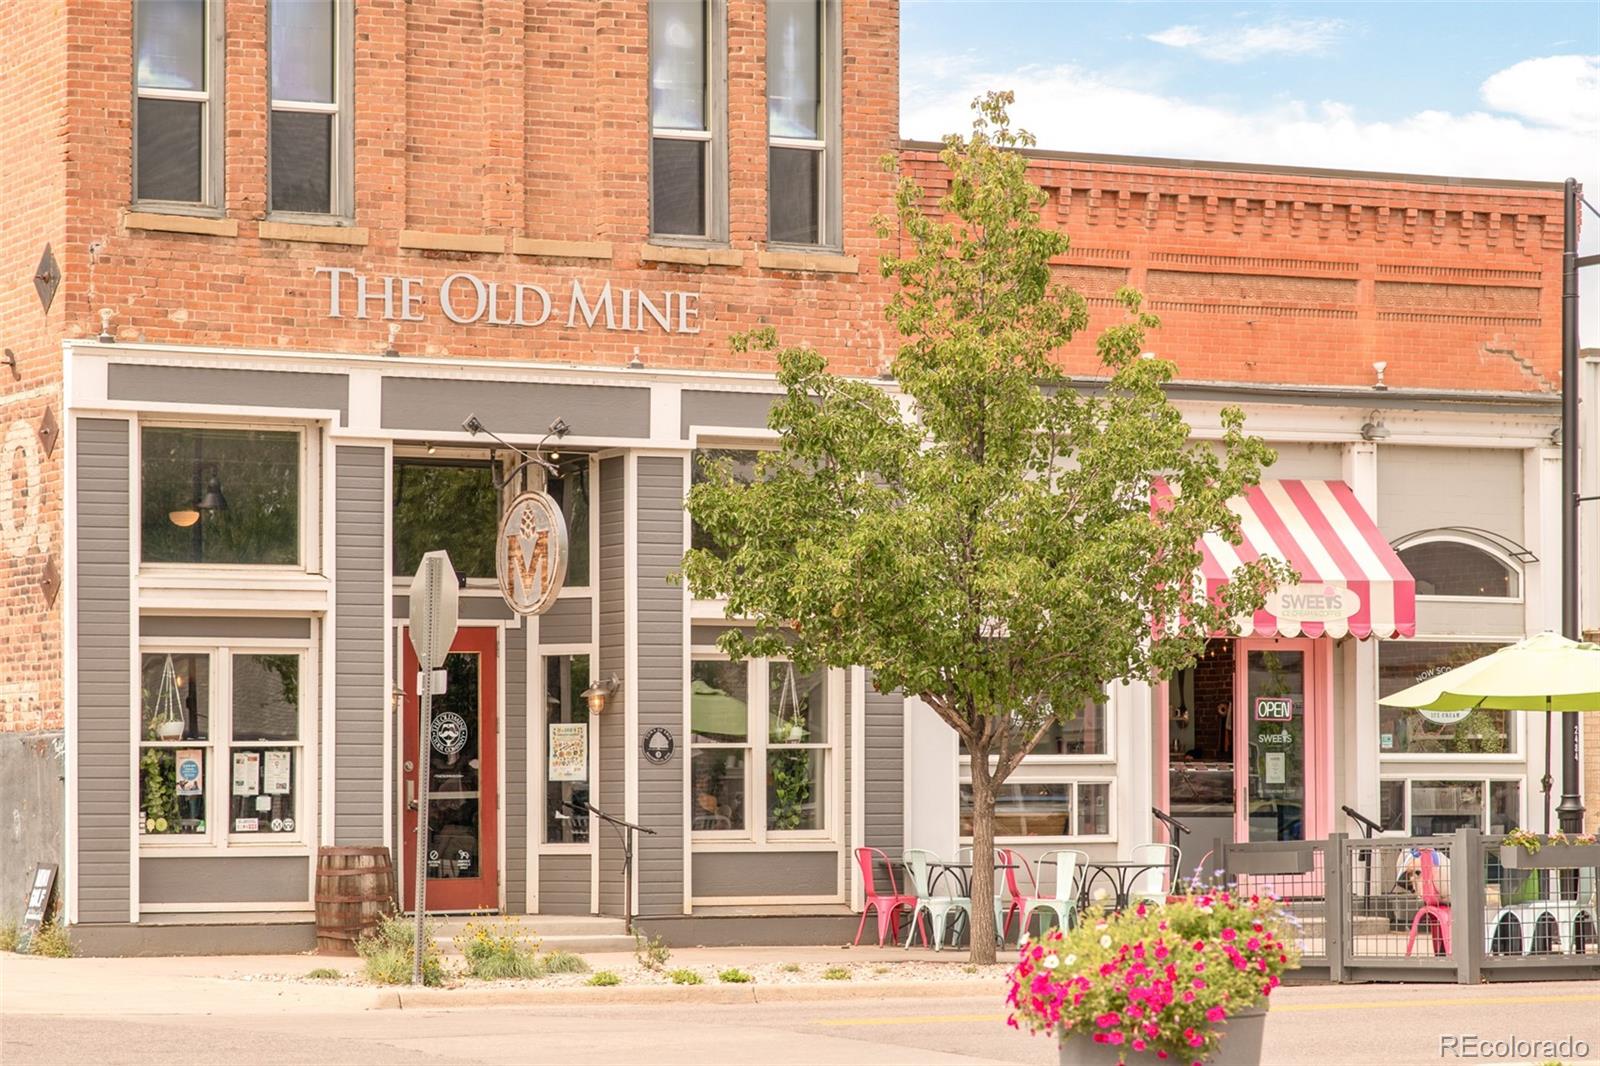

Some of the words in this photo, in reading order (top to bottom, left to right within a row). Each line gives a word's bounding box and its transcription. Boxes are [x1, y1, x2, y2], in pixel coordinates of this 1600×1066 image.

[315, 266, 424, 321] THE
[440, 273, 551, 327] OLD
[566, 279, 700, 334] MINE
[1281, 589, 1343, 609] SWEETS
[1416, 669, 1435, 683] NOW
[1258, 701, 1290, 717] OPEN
[1258, 732, 1292, 743] SWEETS
